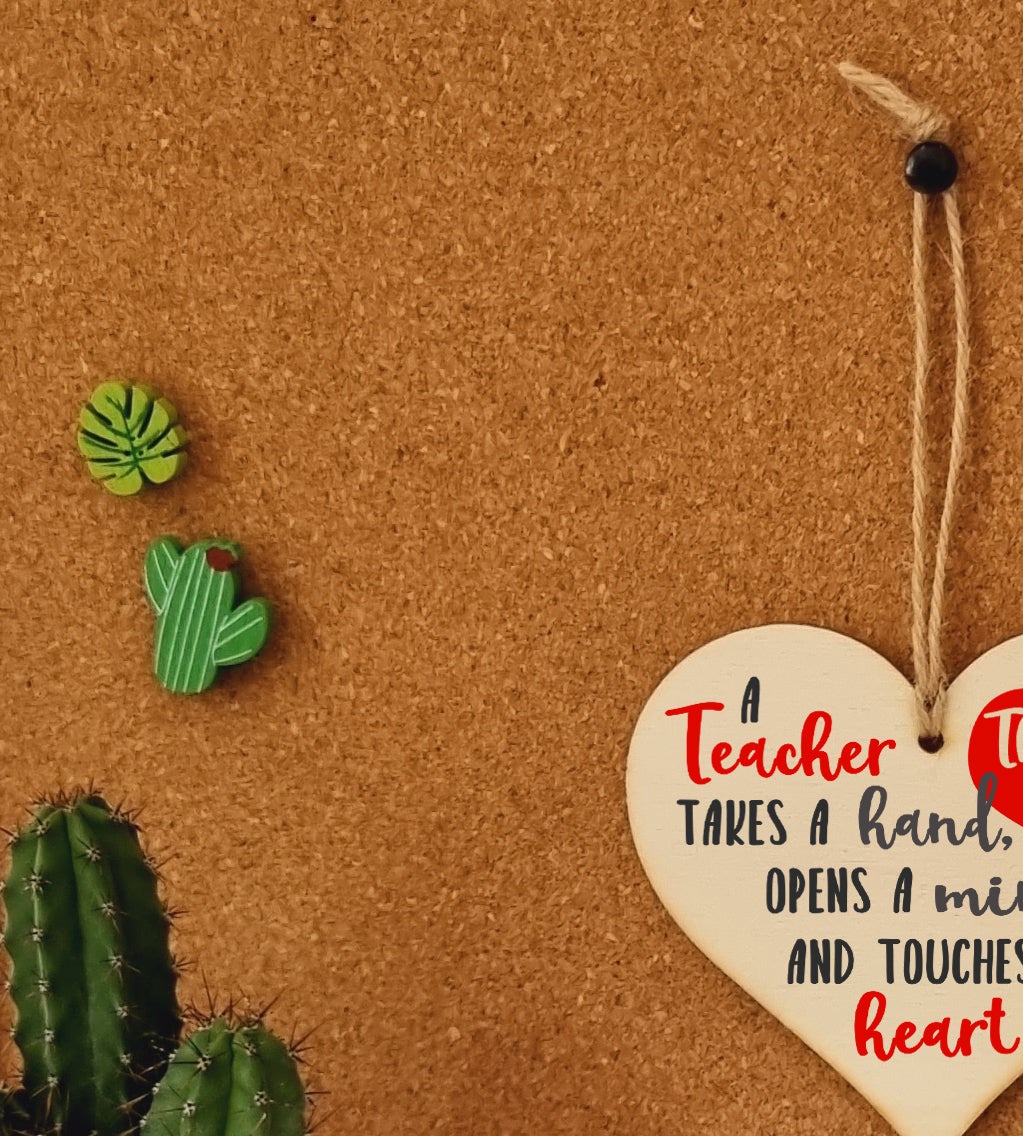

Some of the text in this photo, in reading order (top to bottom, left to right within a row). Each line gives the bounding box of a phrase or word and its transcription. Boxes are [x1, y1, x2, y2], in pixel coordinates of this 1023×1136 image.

[741, 676, 761, 724] A
[665, 701, 896, 785] Teacher
[677, 771, 1013, 853] TAKES A hand,
[766, 866, 870, 914] OPENS
[893, 866, 913, 913] A
[787, 938, 854, 986] AND
[853, 990, 1020, 1061] heart
